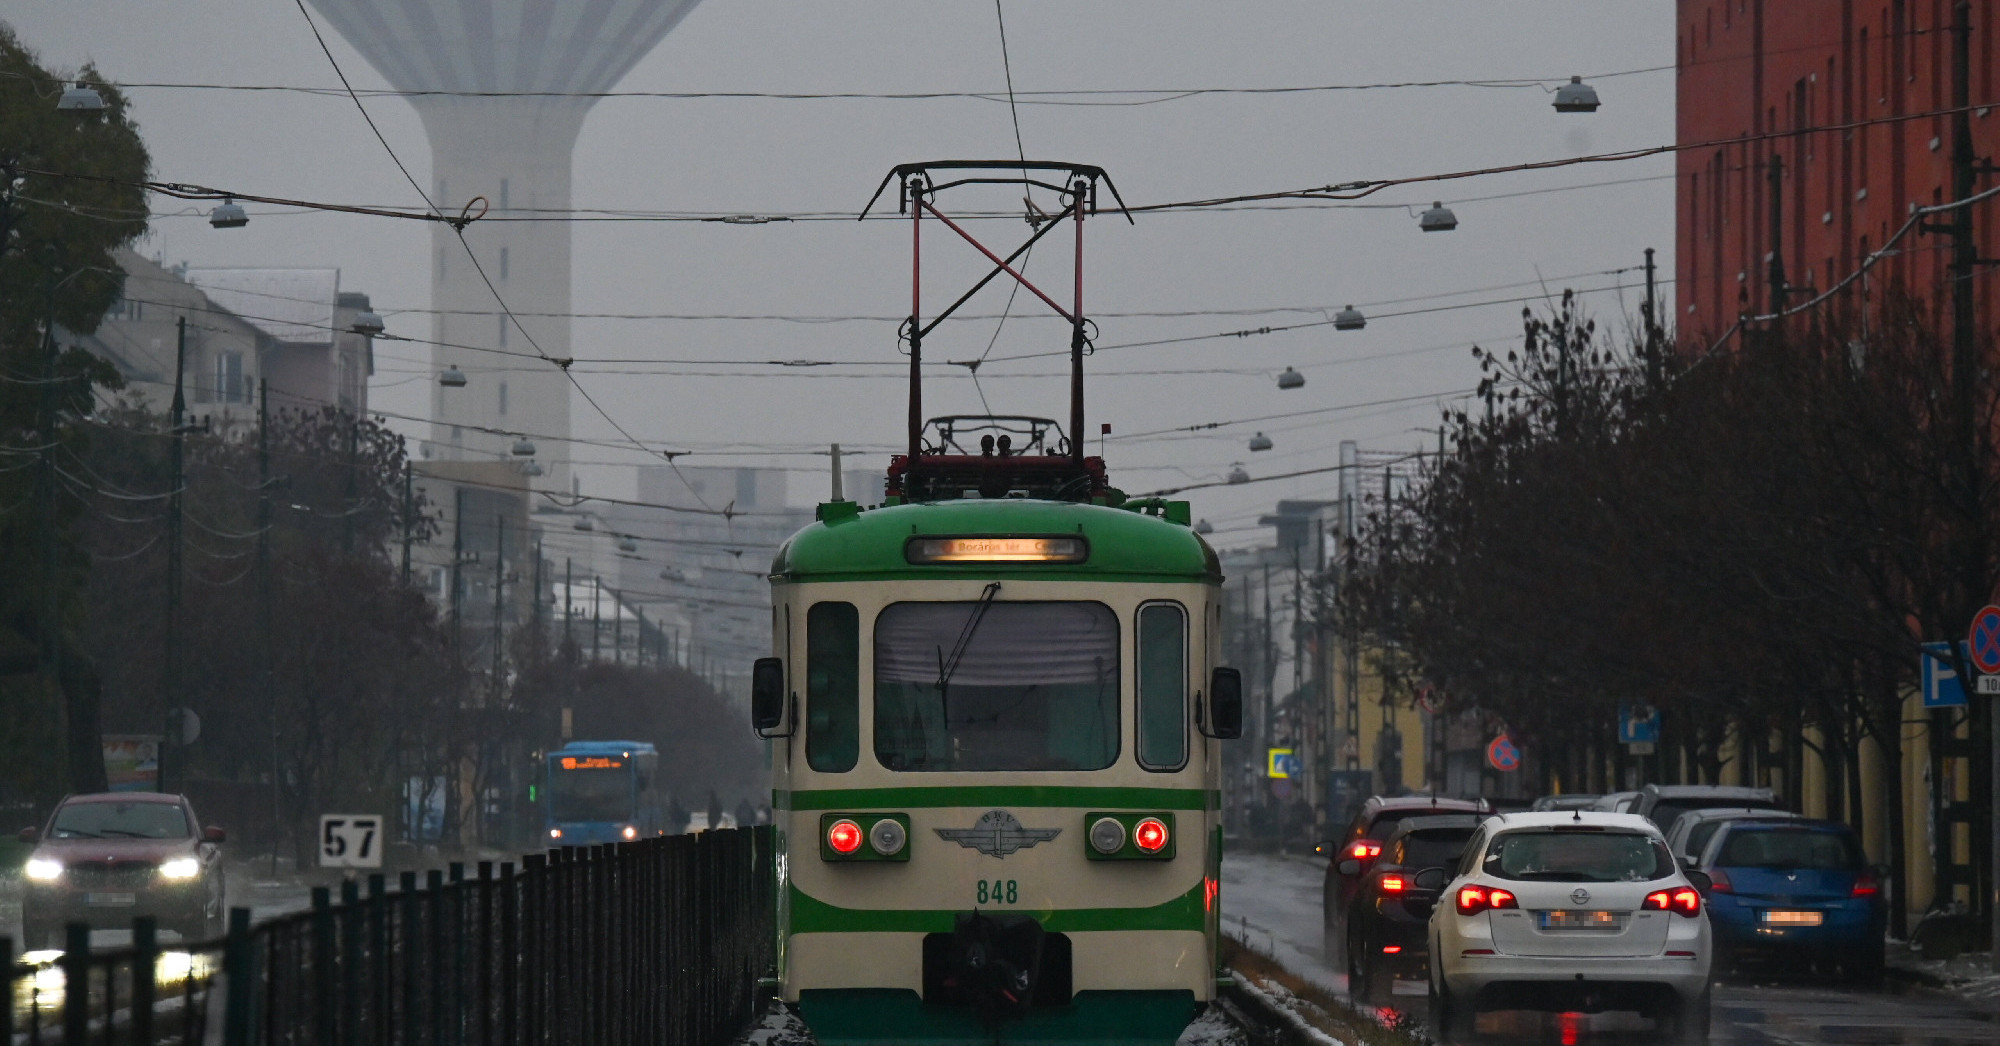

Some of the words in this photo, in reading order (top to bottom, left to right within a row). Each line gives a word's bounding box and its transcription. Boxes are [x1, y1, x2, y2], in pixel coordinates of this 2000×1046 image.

[1984, 678, 2000, 691] 10
[325, 820, 376, 858] 57
[977, 879, 1018, 905] 848
